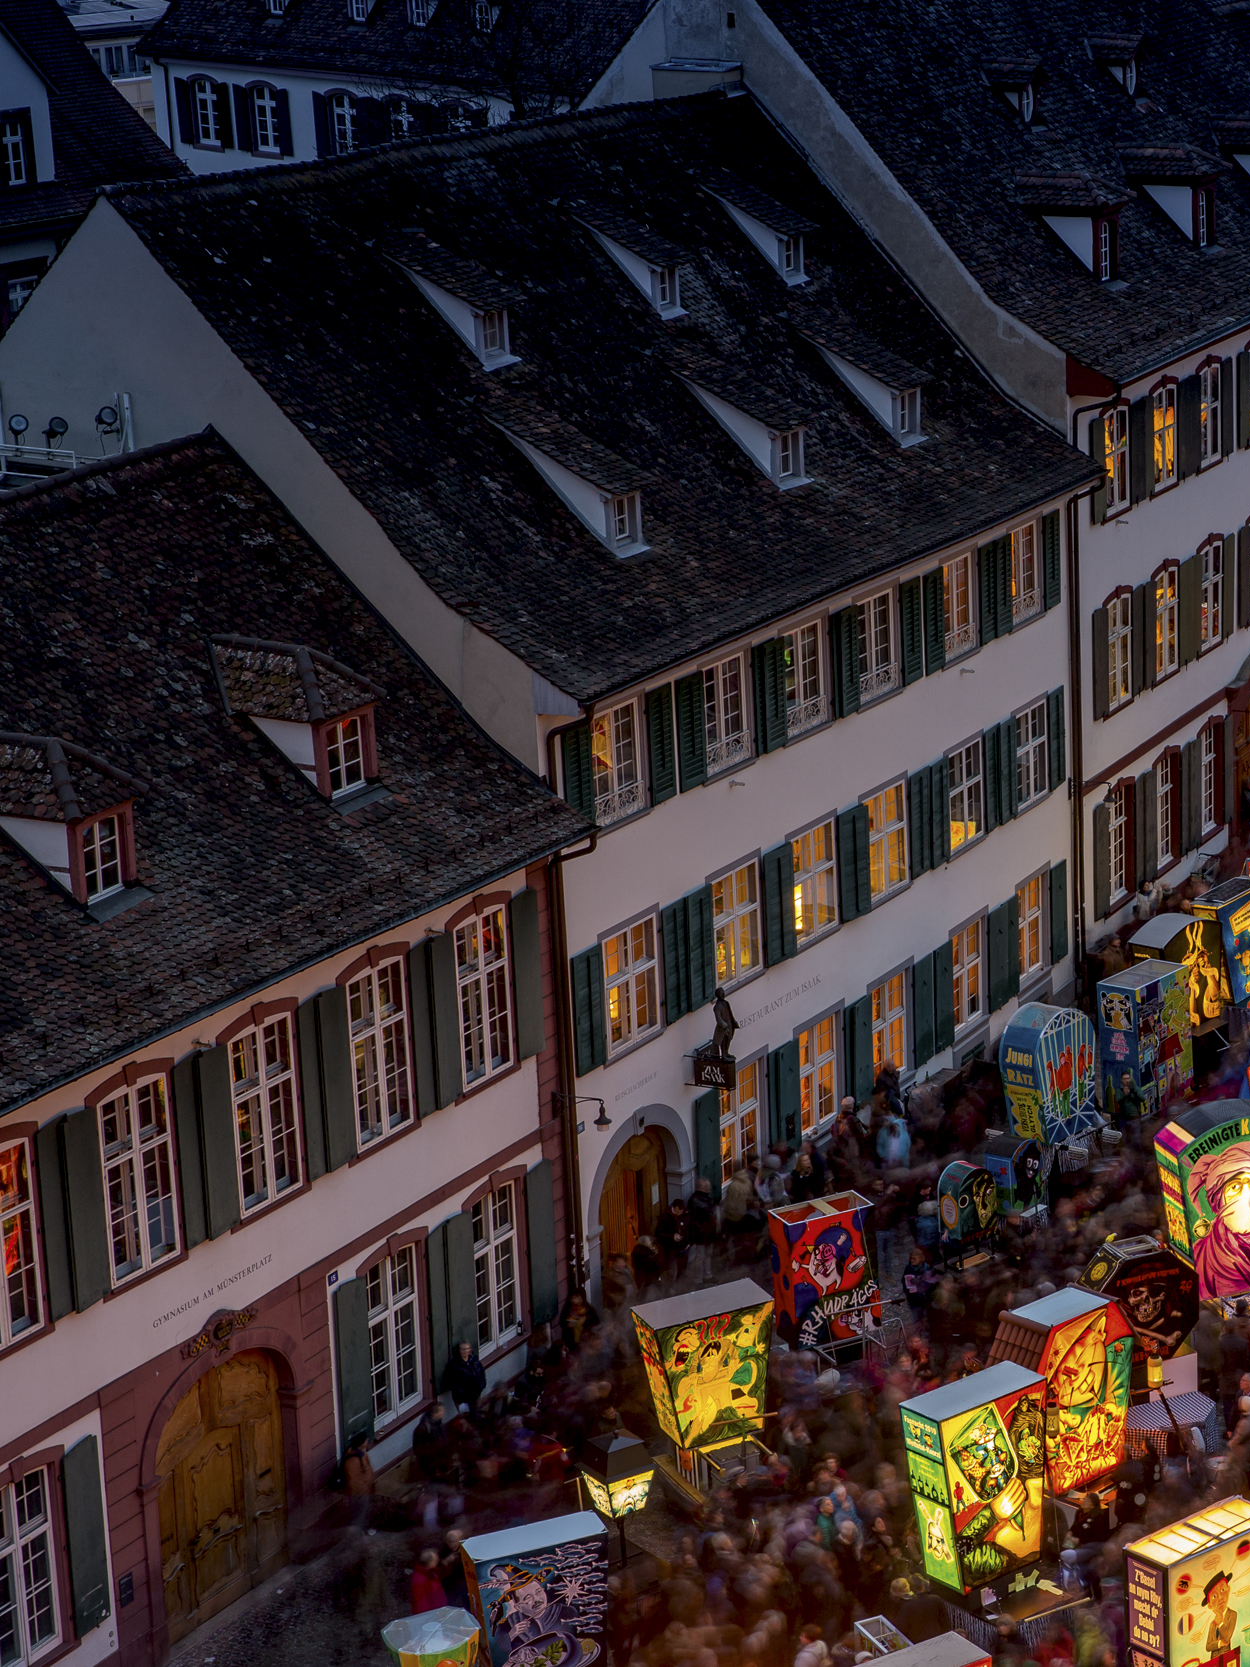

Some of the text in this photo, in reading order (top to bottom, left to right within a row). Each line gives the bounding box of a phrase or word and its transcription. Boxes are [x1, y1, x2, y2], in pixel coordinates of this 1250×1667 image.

[739, 974, 822, 1030] RESTAURANT ZUM ISAAK
[1005, 1048, 1033, 1068] JUNGI
[1006, 1069, 1034, 1086] RÄTZ
[152, 1254, 273, 1329] GYMNASIUM AM MÜNSTERPLATZ
